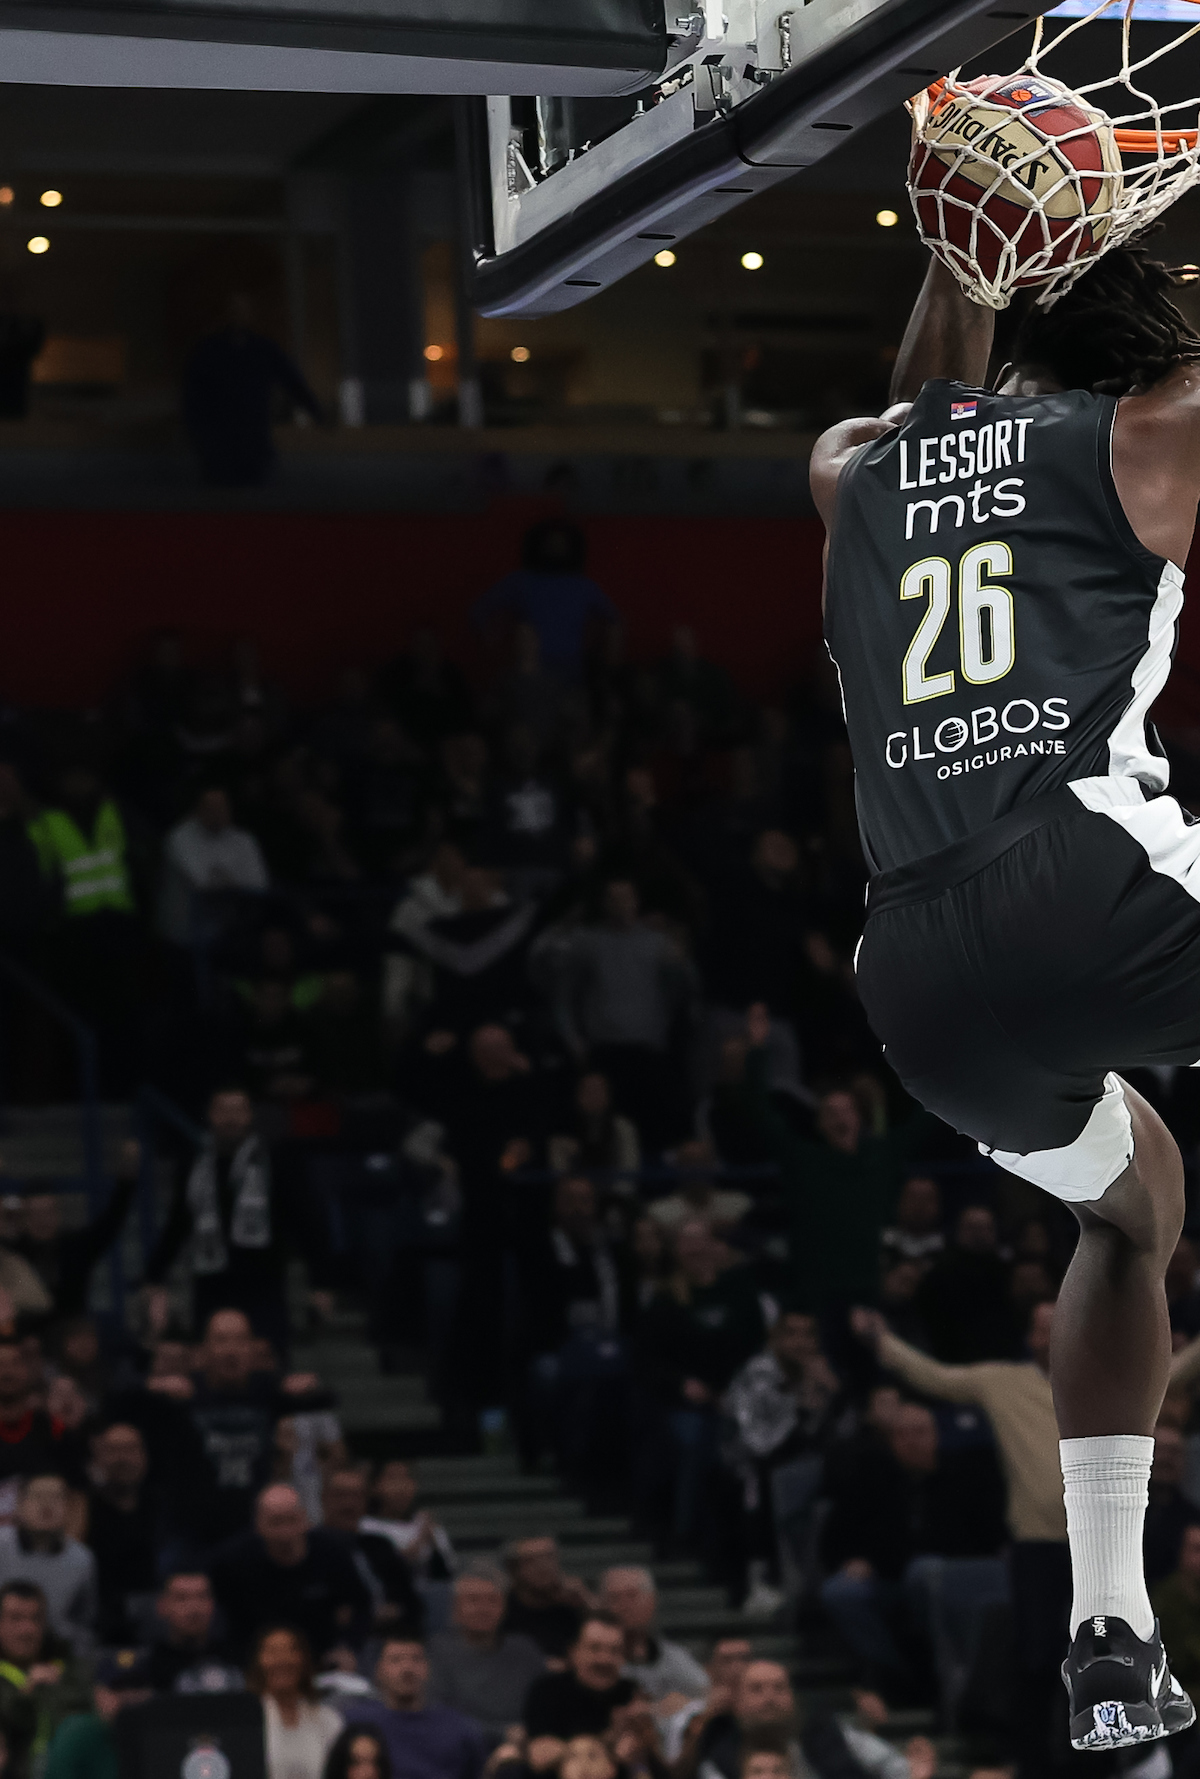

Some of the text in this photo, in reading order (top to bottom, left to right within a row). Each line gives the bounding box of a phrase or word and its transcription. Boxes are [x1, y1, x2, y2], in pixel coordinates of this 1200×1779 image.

[899, 417, 1034, 491] LESSORT
[904, 477, 1027, 540] mts
[899, 540, 1016, 706] 26
[885, 697, 1071, 769] GLOBOS
[936, 739, 1067, 781] OSIGURANJE
